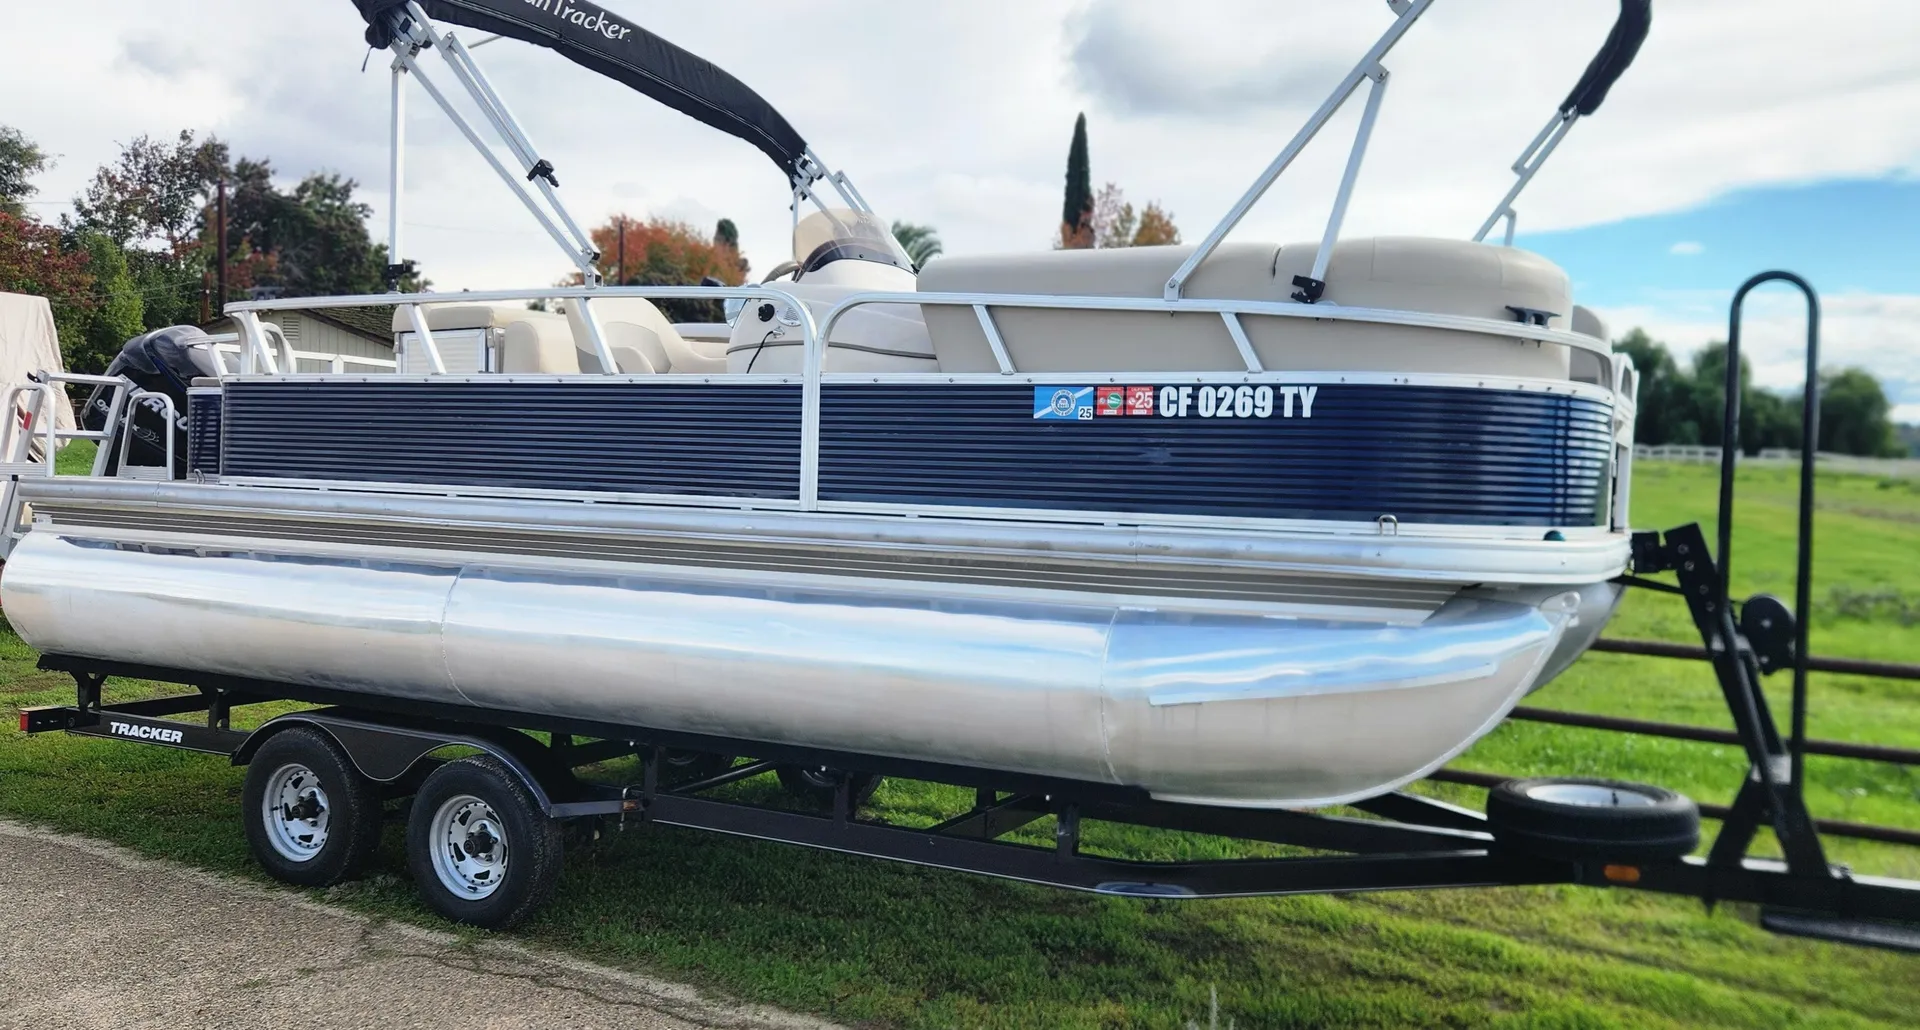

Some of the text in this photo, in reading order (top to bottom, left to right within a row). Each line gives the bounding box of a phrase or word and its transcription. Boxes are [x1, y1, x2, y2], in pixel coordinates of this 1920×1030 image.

[1135, 391, 1153, 408] 25
[1159, 386, 1318, 418] CF 0269 TY
[1079, 408, 1092, 418] 25
[110, 722, 183, 743] TRACKER
